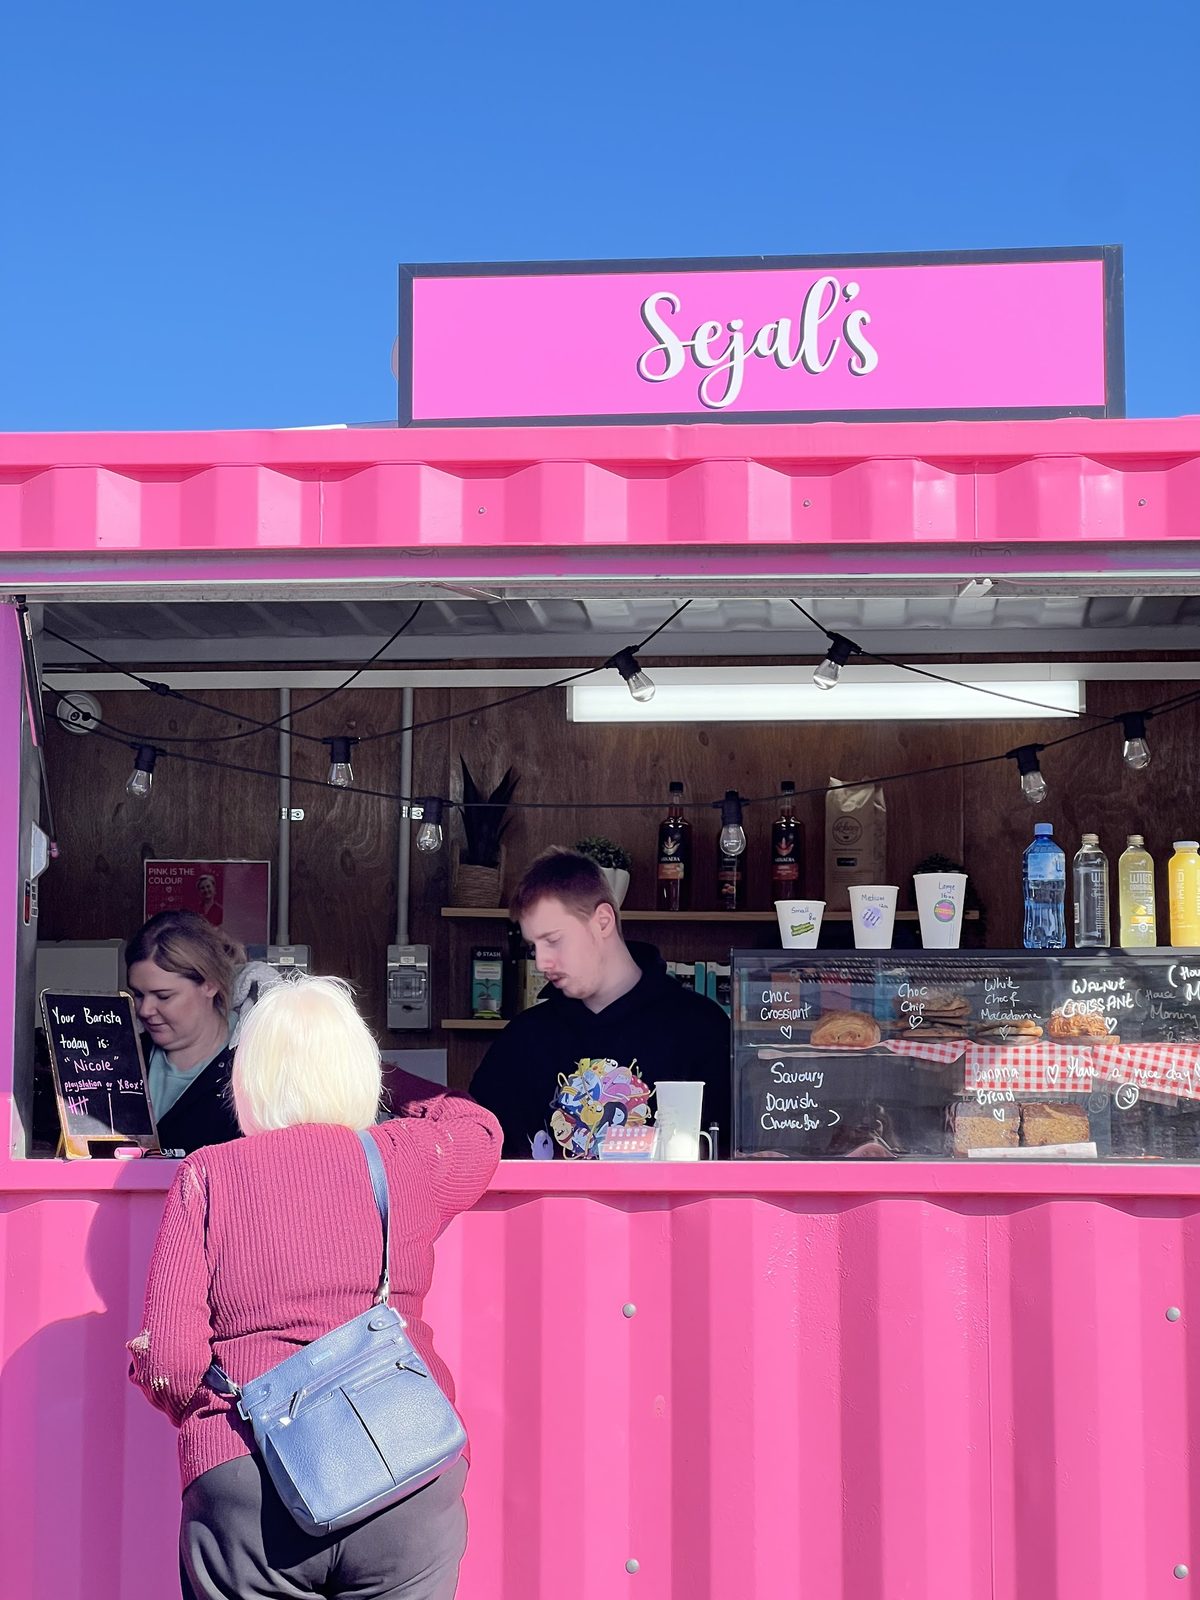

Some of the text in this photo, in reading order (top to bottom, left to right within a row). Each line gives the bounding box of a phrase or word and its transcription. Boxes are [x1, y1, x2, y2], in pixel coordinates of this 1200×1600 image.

[637, 276, 879, 410] Sejal's
[148, 867, 195, 876] PINK IS THE
[148, 877, 183, 885] COLOUR
[939, 882, 955, 893] Large
[861, 894, 885, 902] Medium
[762, 990, 793, 1004] Choc
[897, 983, 928, 998] Choc
[52, 1006, 122, 1025] Your Barista
[760, 1002, 812, 1021] Crossiant
[900, 1000, 925, 1015] Chip
[60, 1034, 110, 1057] today is:
[770, 1061, 824, 1088] Savoury
[973, 1063, 1020, 1082] Banana
[1112, 1069, 1121, 1078] a
[1134, 1065, 1161, 1080] nice
[1166, 1062, 1192, 1097] day
[106, 1082, 113, 1090] or
[765, 1092, 818, 1112] Danish
[976, 1089, 1015, 1105] Bread
